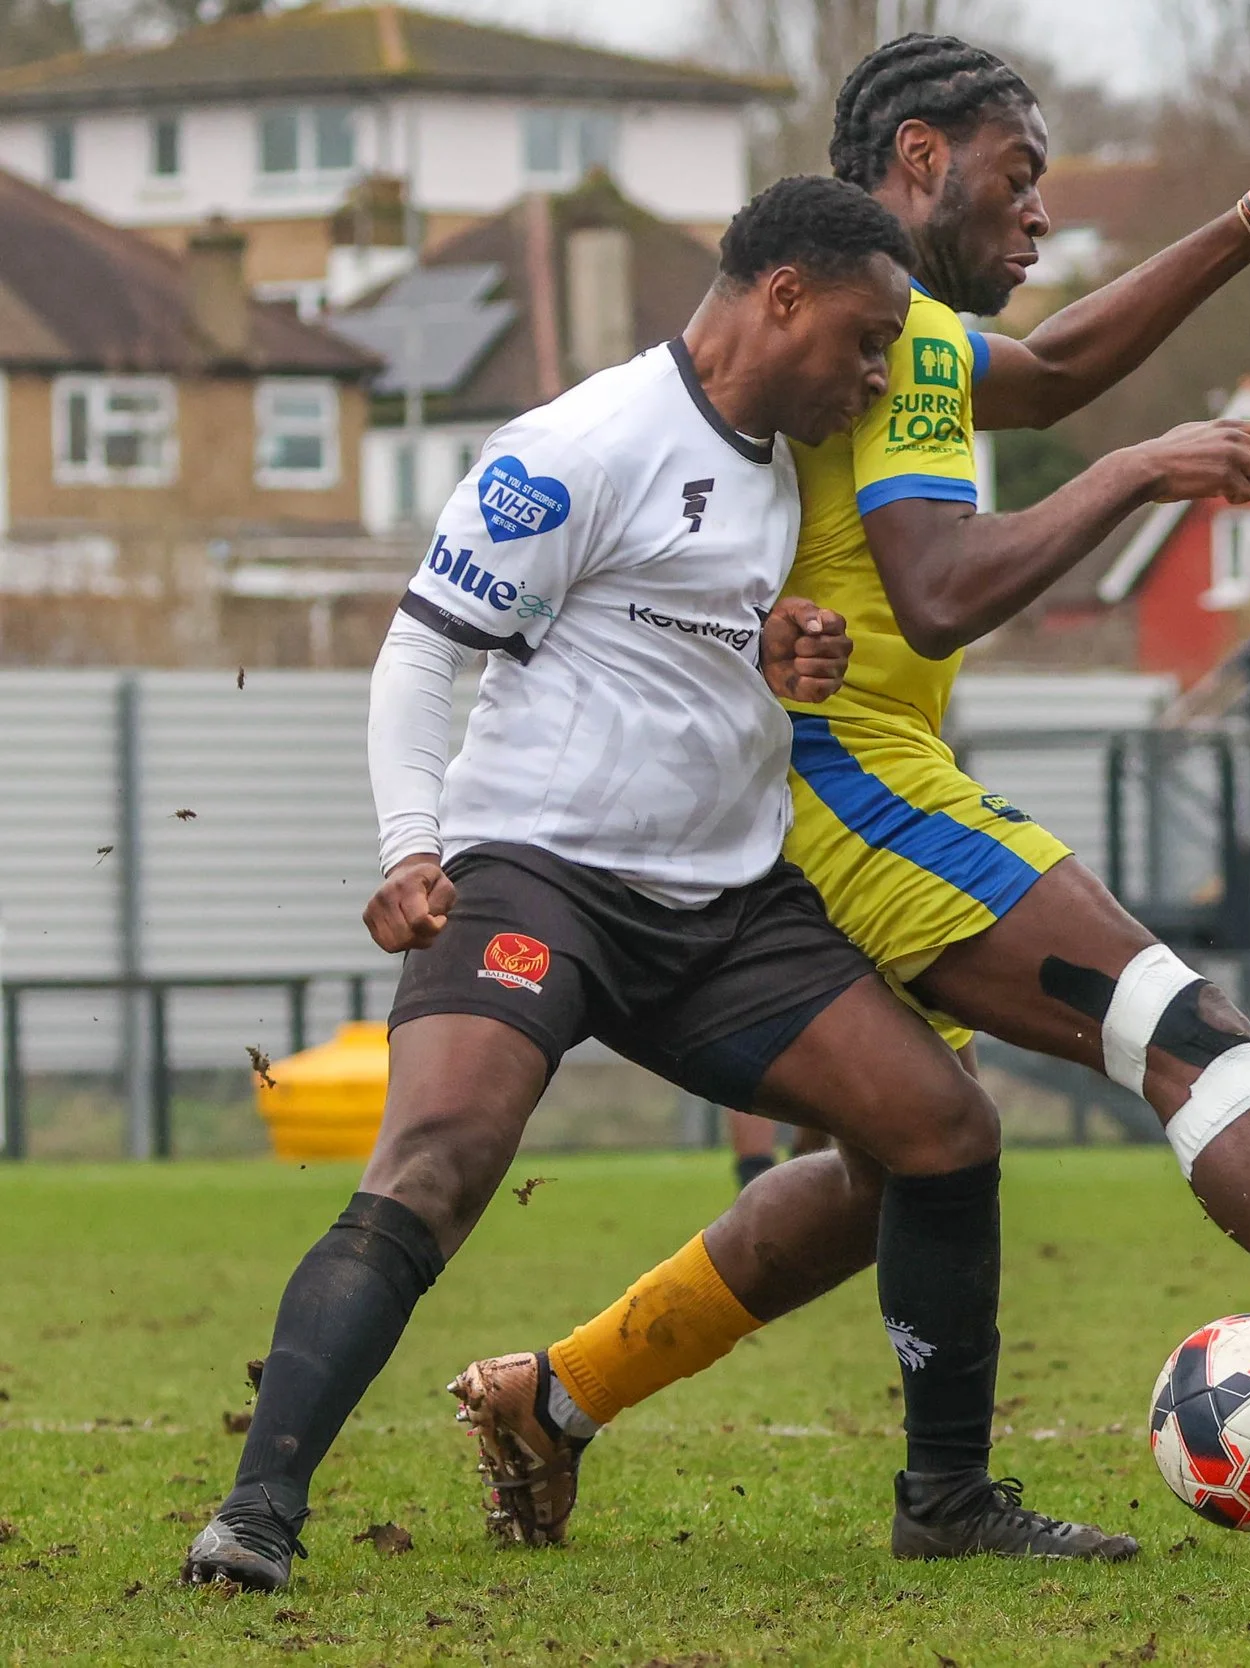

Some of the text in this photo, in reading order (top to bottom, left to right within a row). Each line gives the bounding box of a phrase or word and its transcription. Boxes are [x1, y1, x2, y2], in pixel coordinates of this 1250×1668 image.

[891, 393, 961, 416] SURRE
[521, 484, 533, 494] ST
[487, 486, 542, 524] NHS
[491, 514, 518, 533] HEROES
[428, 535, 517, 611] blue
[485, 971, 523, 983] BALHAM
